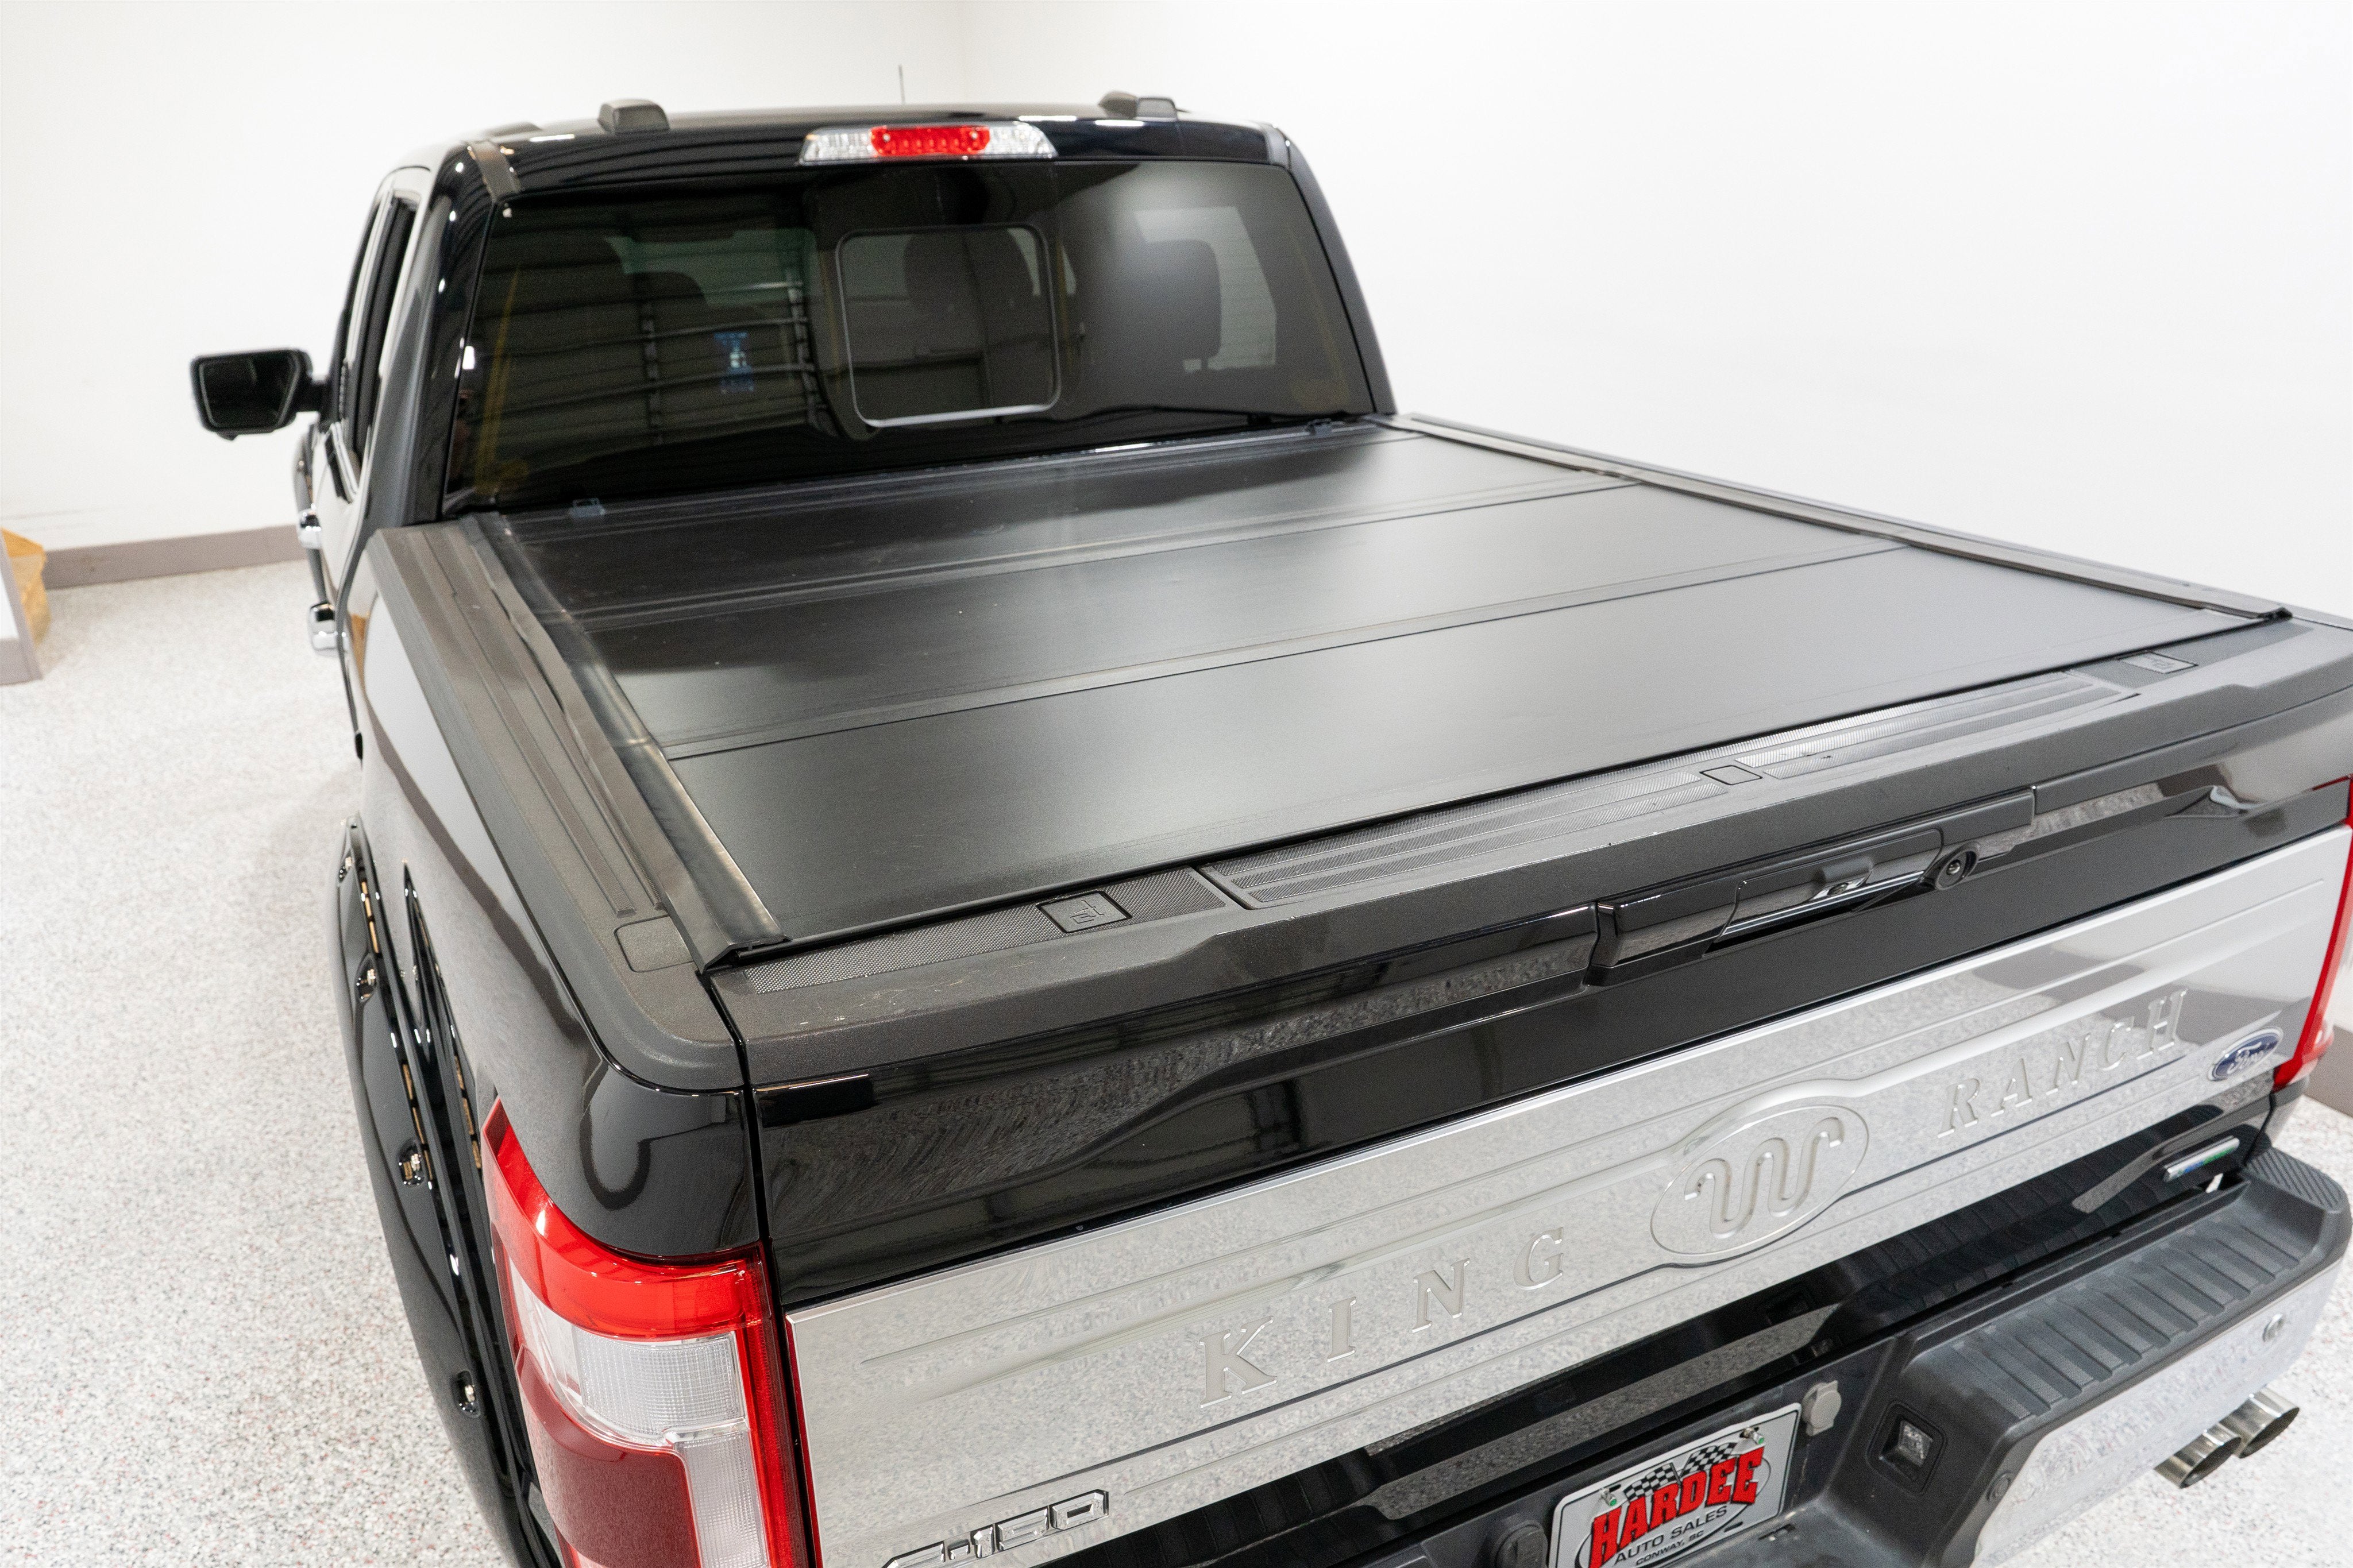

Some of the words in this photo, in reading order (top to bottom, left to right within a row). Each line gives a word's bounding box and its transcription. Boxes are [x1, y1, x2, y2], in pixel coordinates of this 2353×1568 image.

[1199, 1226, 1564, 1408] KING
[1937, 987, 2189, 1138] RANCH
[1588, 1445, 1765, 1568] HARDEE
[1613, 1534, 1664, 1566] AUTO
[1671, 1505, 1727, 1539] SALES
[1635, 1539, 1685, 1566] CONWAY,
